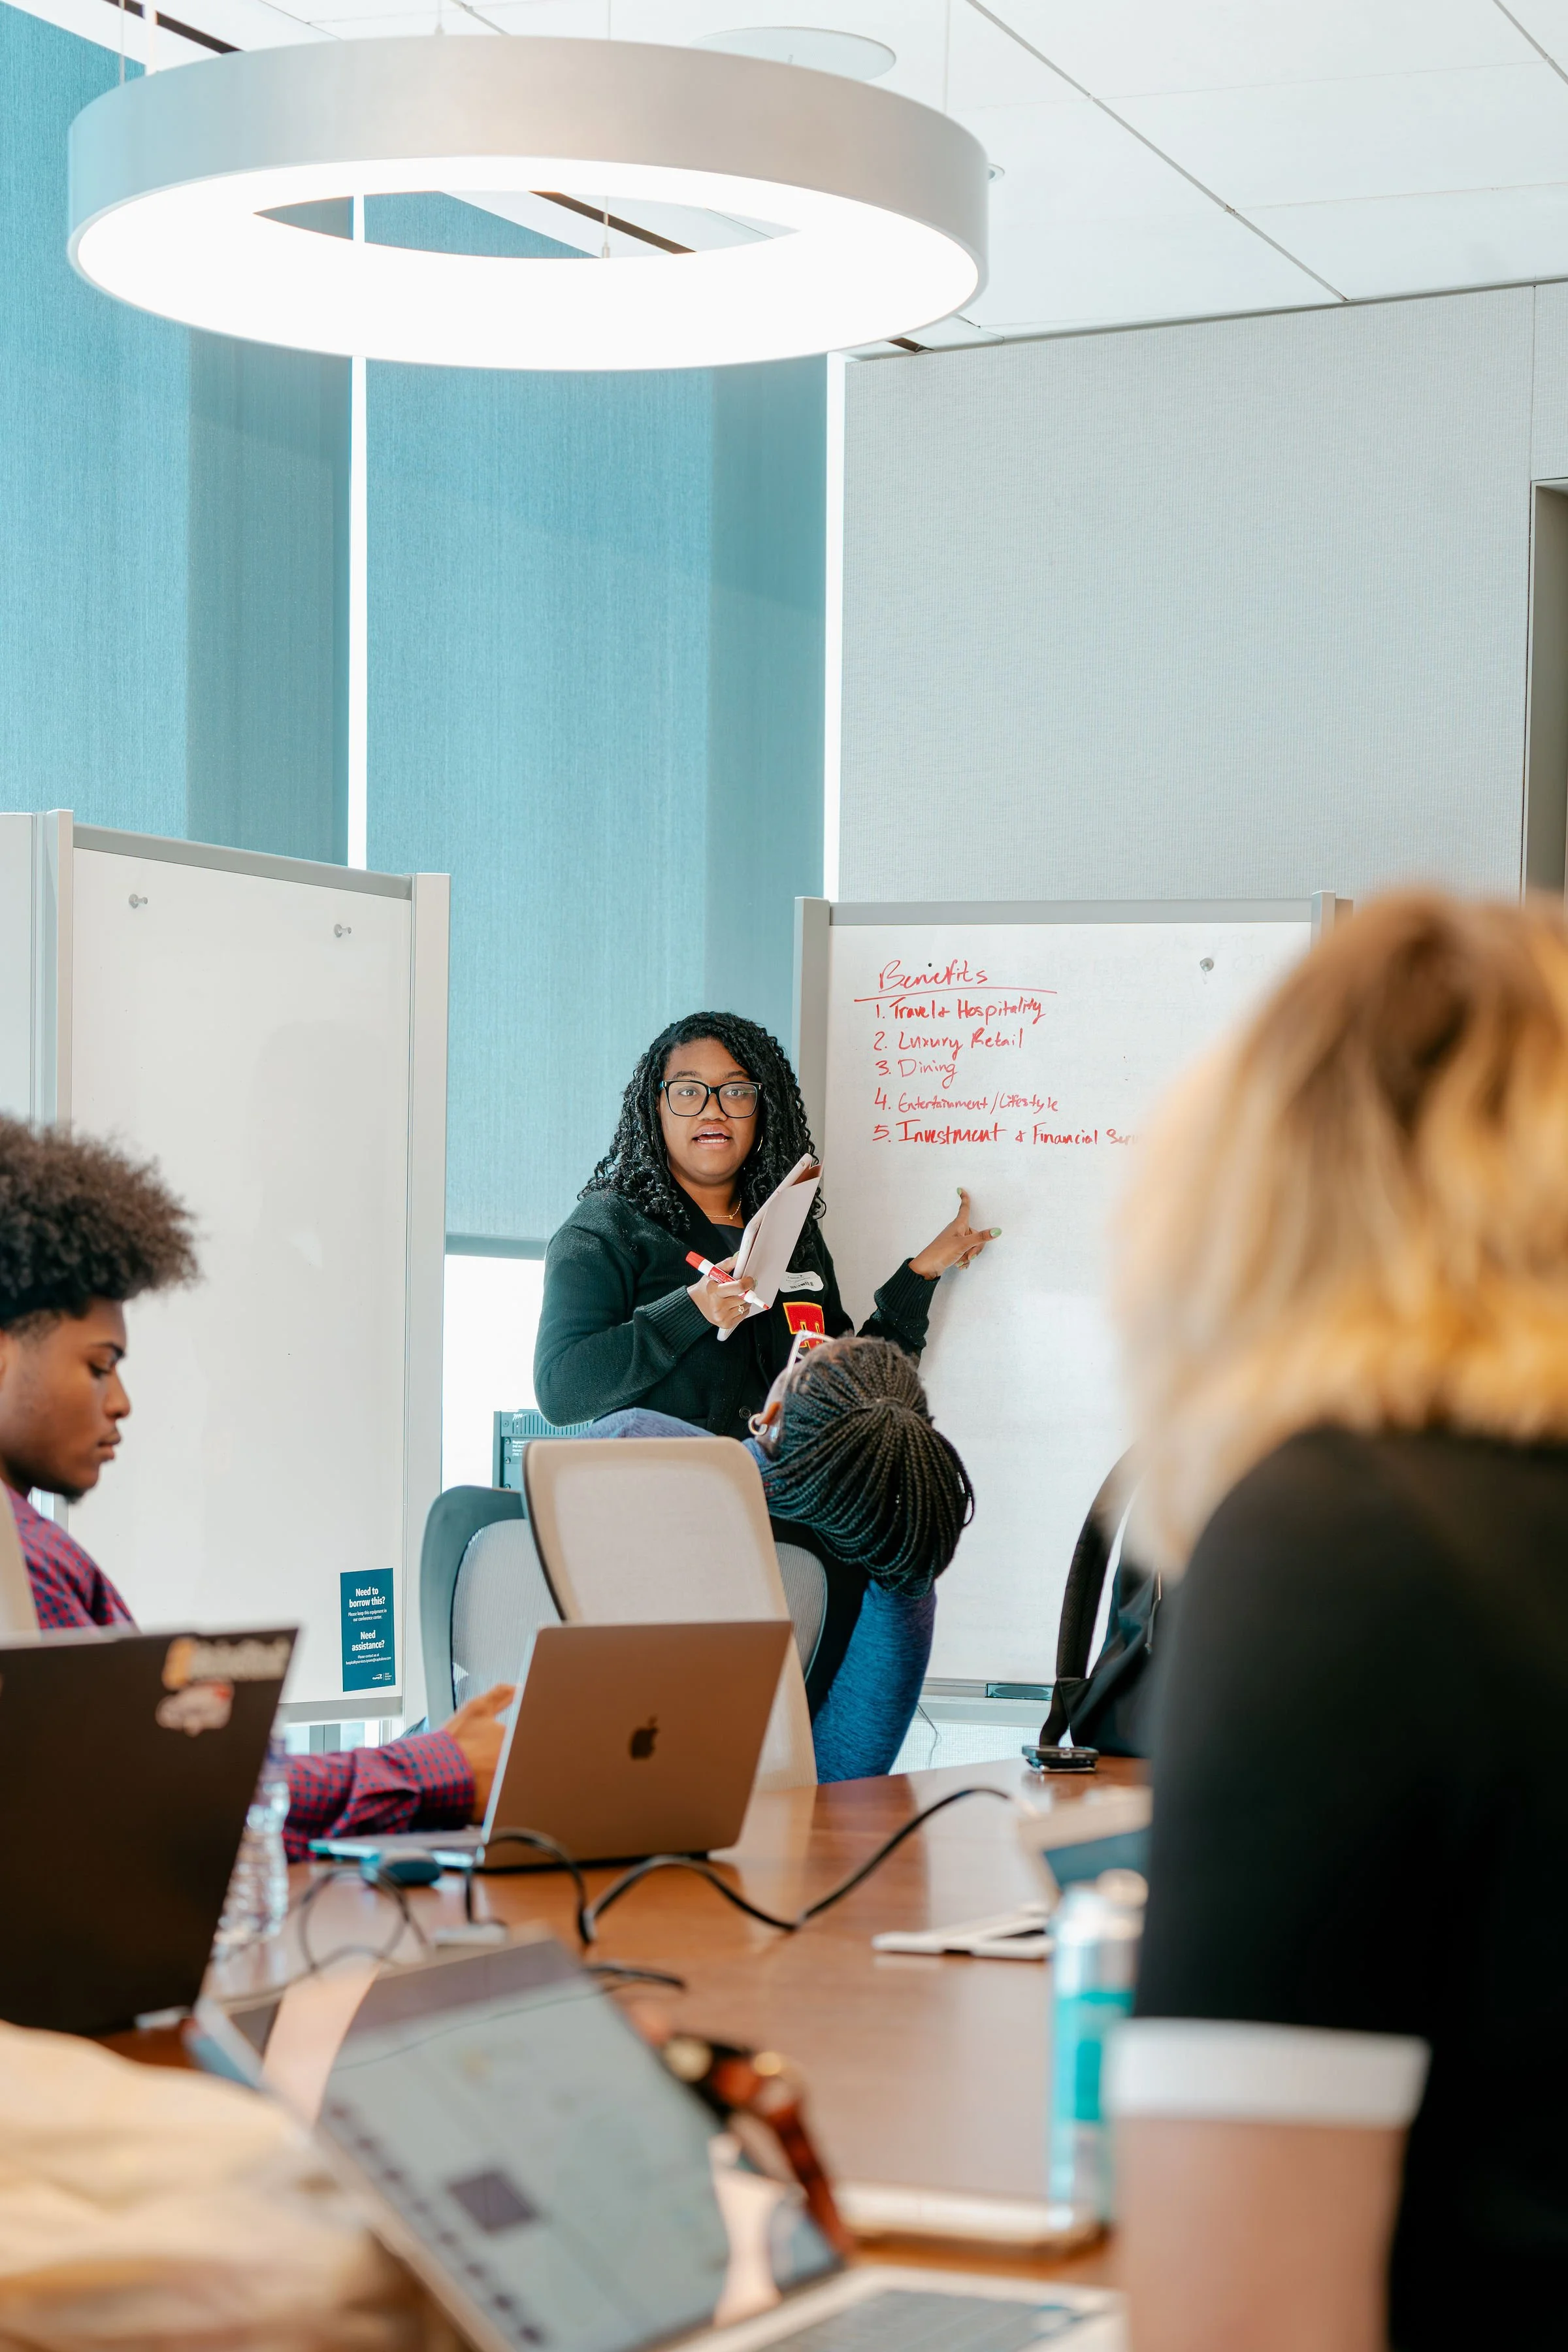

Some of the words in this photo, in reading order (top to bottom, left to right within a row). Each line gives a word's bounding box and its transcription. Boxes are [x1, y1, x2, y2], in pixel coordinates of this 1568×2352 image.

[879, 959, 988, 992] Benefits
[875, 1004, 885, 1019] 1.
[957, 996, 1045, 1025] Hospitality
[873, 1031, 888, 1051] 2.
[898, 1031, 963, 1061] Luxury
[970, 1027, 1023, 1049] Retail
[875, 1060, 891, 1076] 3.
[897, 1058, 957, 1089] Dining
[874, 1086, 891, 1111] 4.
[872, 1124, 892, 1143] 5.
[895, 1119, 1007, 1145] Investment
[1032, 1122, 1099, 1145] Financial
[1106, 1128, 1139, 1146] Serv
[349, 1599, 370, 1608] borrow
[371, 1596, 385, 1605] this?
[355, 1586, 371, 1597] Need
[351, 1639, 385, 1652] assistance?
[360, 1629, 376, 1640] Need
